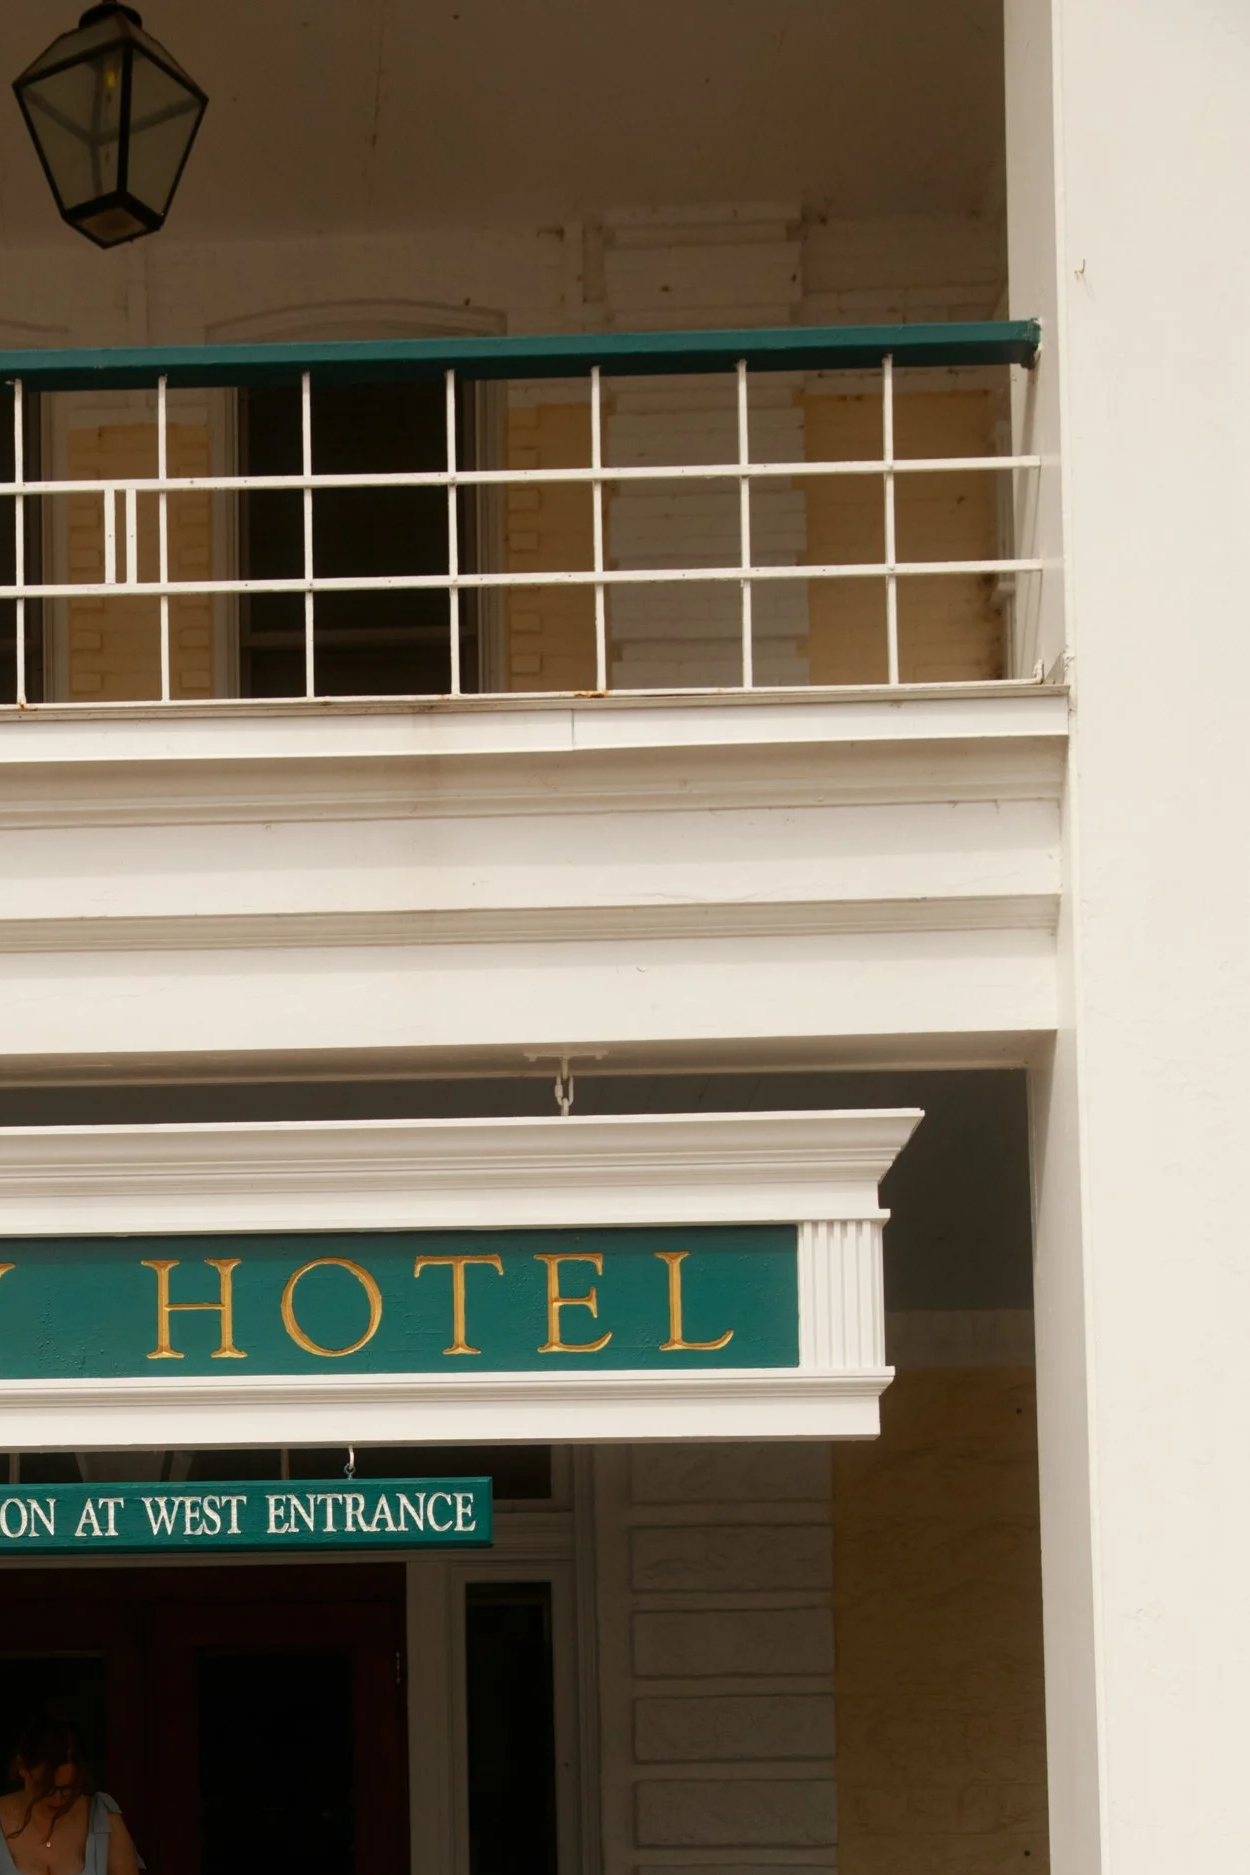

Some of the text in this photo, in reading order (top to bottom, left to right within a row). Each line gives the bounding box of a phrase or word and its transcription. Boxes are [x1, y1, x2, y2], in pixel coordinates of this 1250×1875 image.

[140, 1251, 734, 1359] HOTEL
[74, 1496, 125, 1538] AT
[141, 1494, 248, 1536] WEST
[265, 1491, 477, 1534] ENTRANCE
